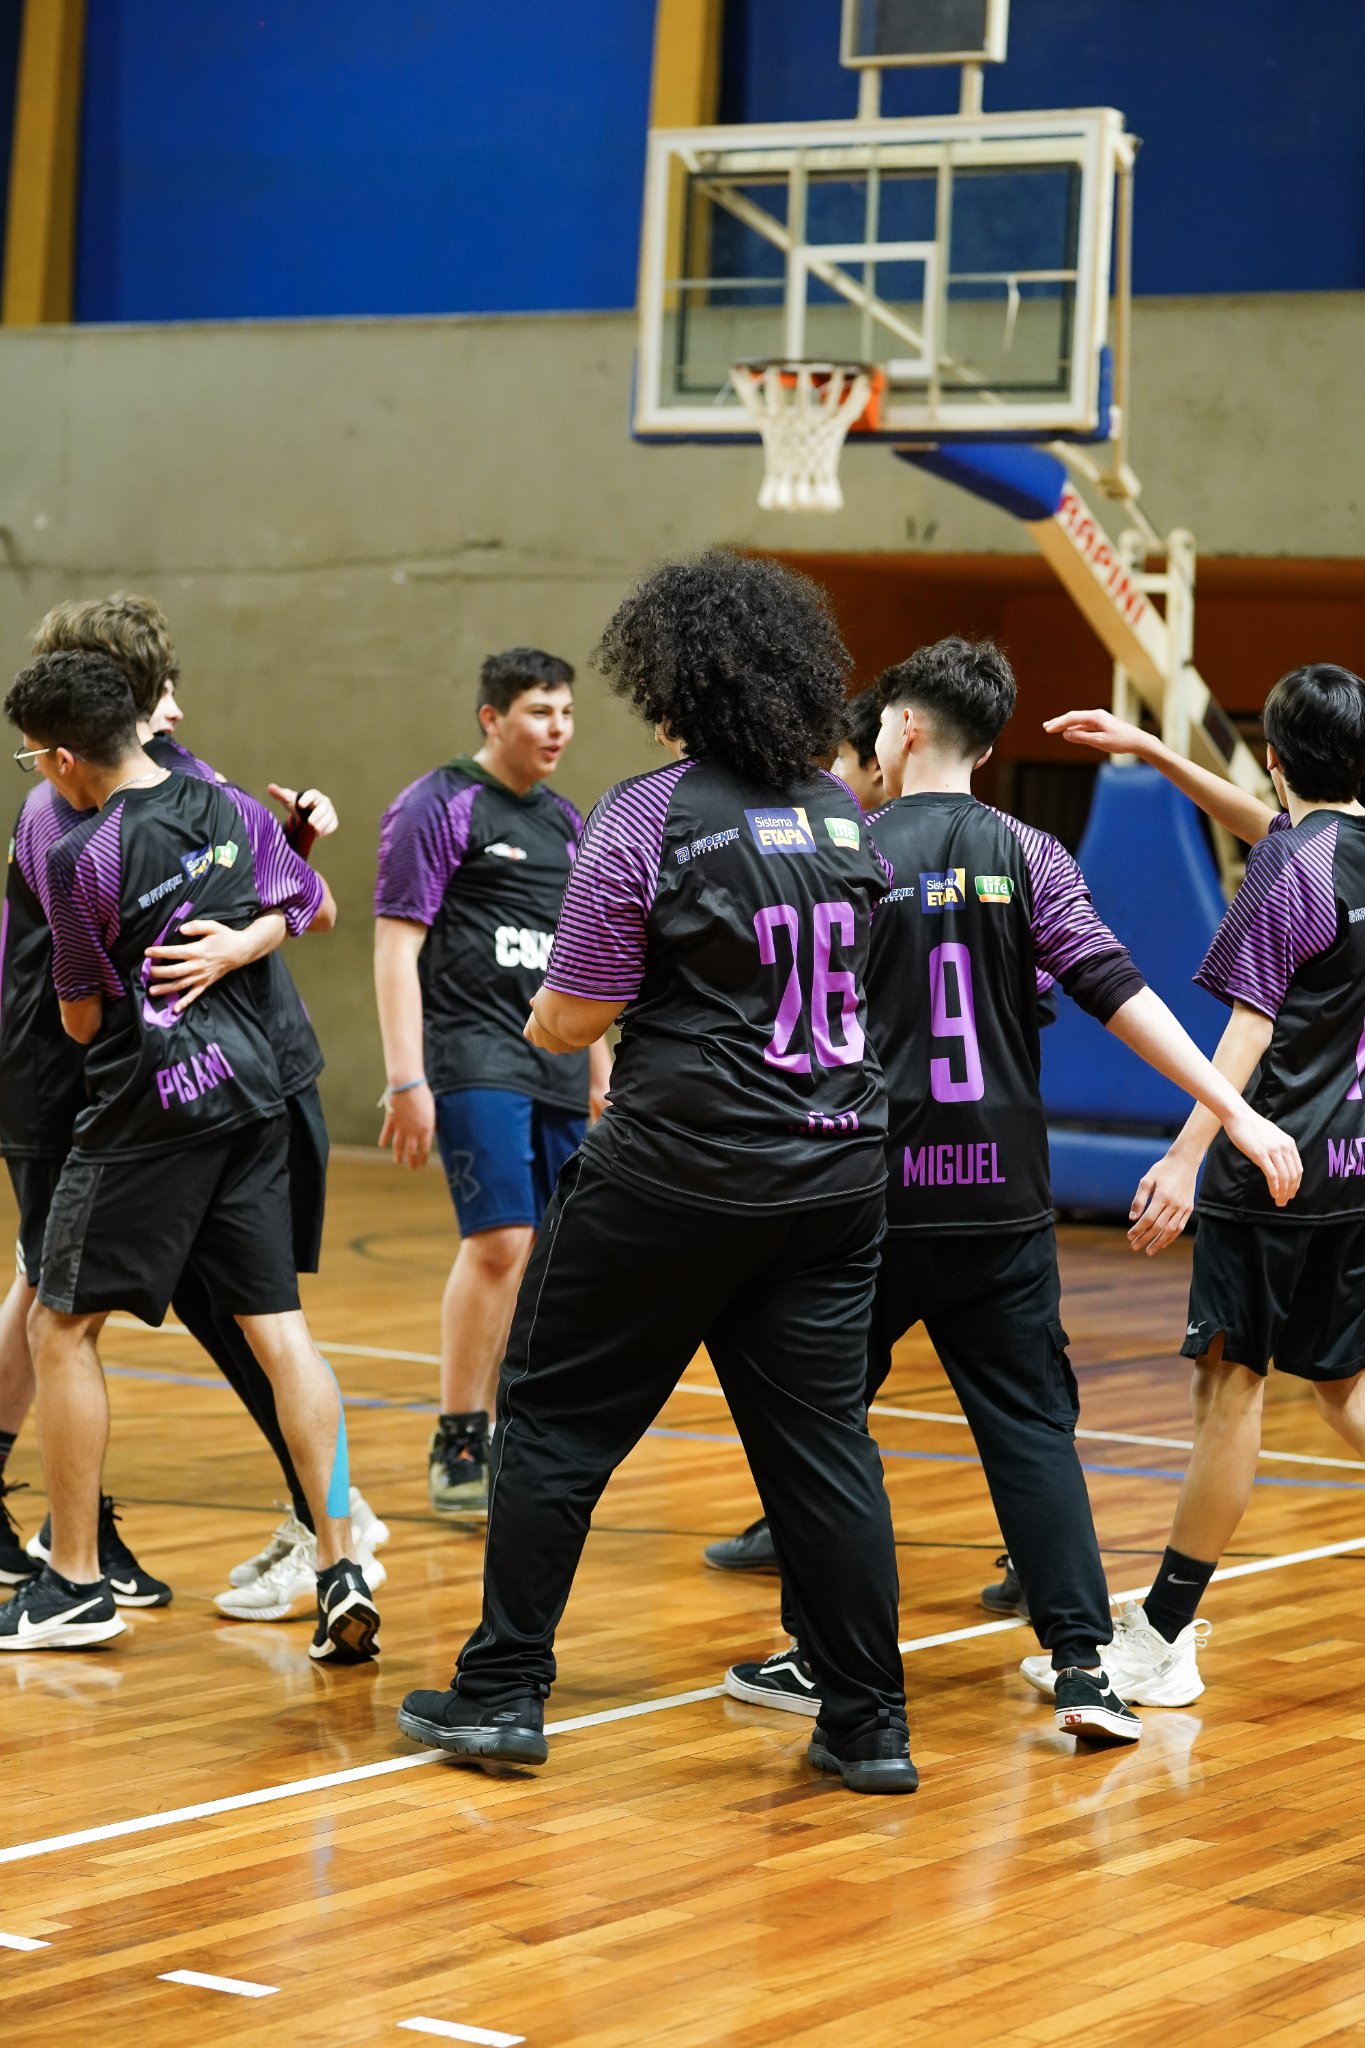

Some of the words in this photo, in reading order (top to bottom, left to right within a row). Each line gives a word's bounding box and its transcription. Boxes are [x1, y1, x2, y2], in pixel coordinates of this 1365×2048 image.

[1057, 494, 1147, 625] RAPINI
[754, 816, 793, 829] Sistema
[758, 829, 808, 847] ETAPA
[982, 878, 1009, 894] life
[753, 902, 866, 1074] 26
[928, 942, 985, 1103] 9
[156, 1042, 235, 1110] PISANI
[903, 1142, 1006, 1187] MIGUEL
